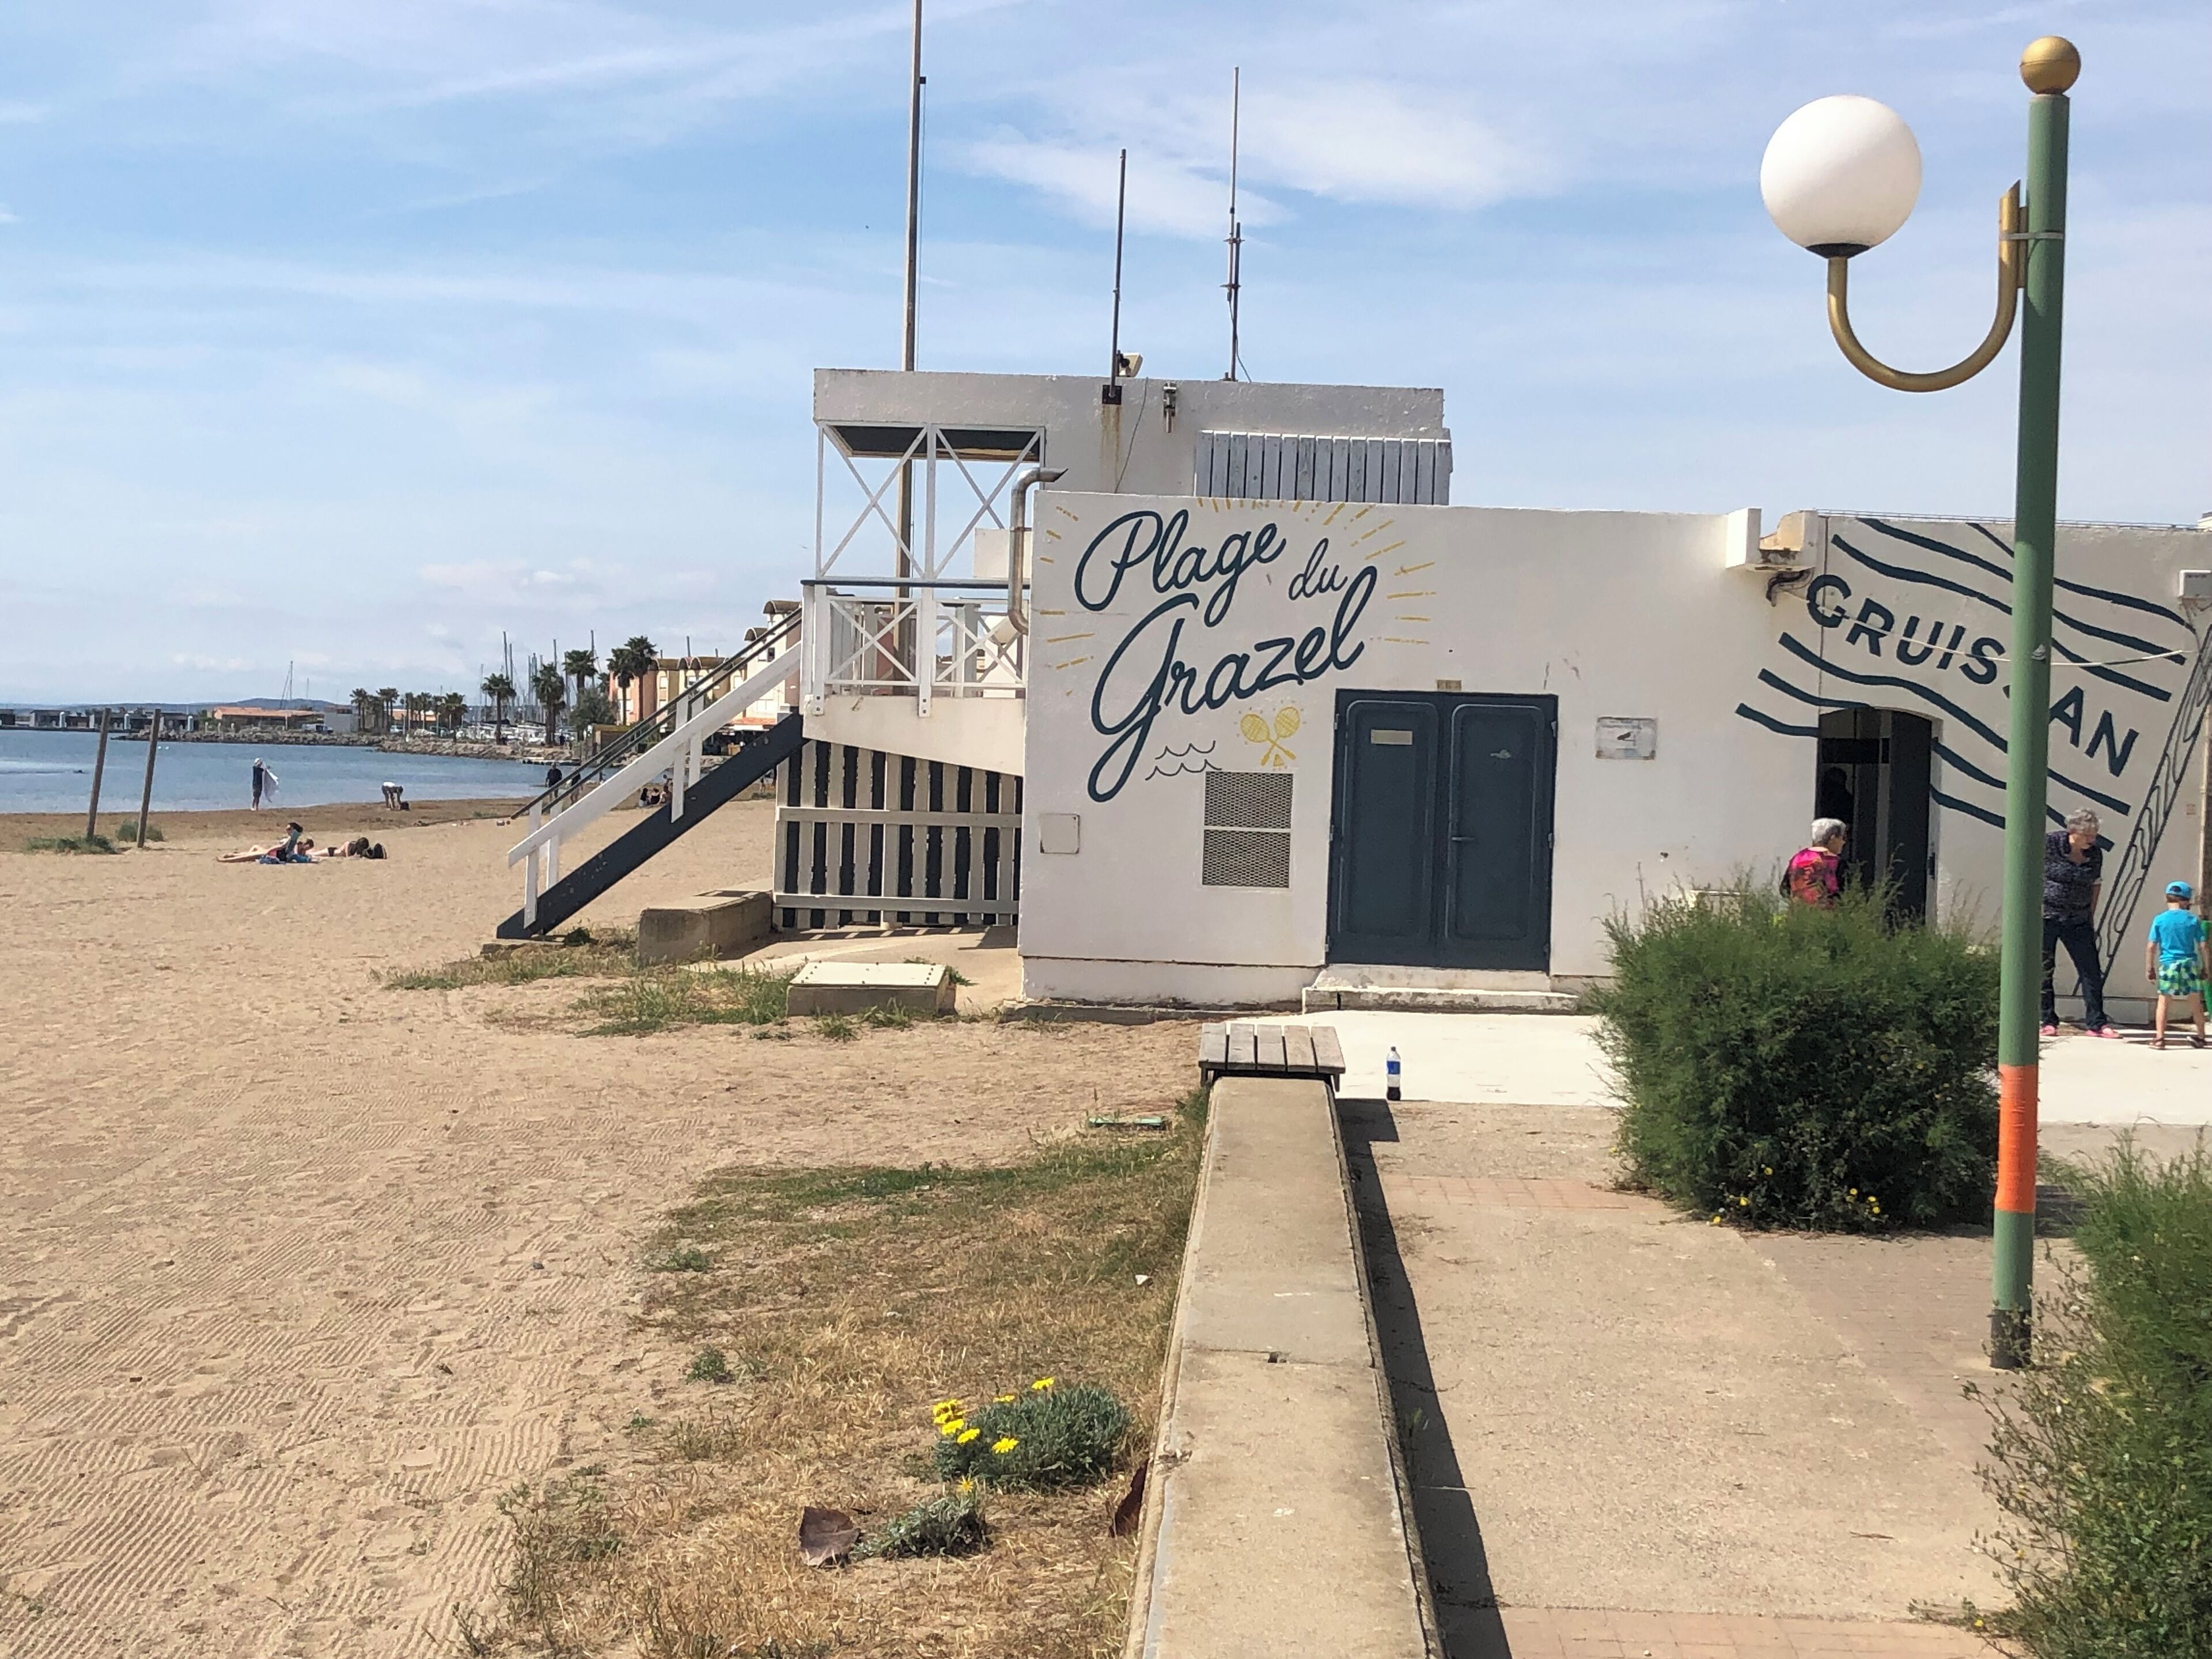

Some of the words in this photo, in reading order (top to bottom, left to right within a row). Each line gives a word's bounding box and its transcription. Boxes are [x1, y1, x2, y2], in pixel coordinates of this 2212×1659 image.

[1075, 509, 1286, 627] Plage
[1289, 538, 1348, 600] du
[1087, 566, 1377, 802] Grazel
[1806, 574, 2139, 777] GRUISAN
